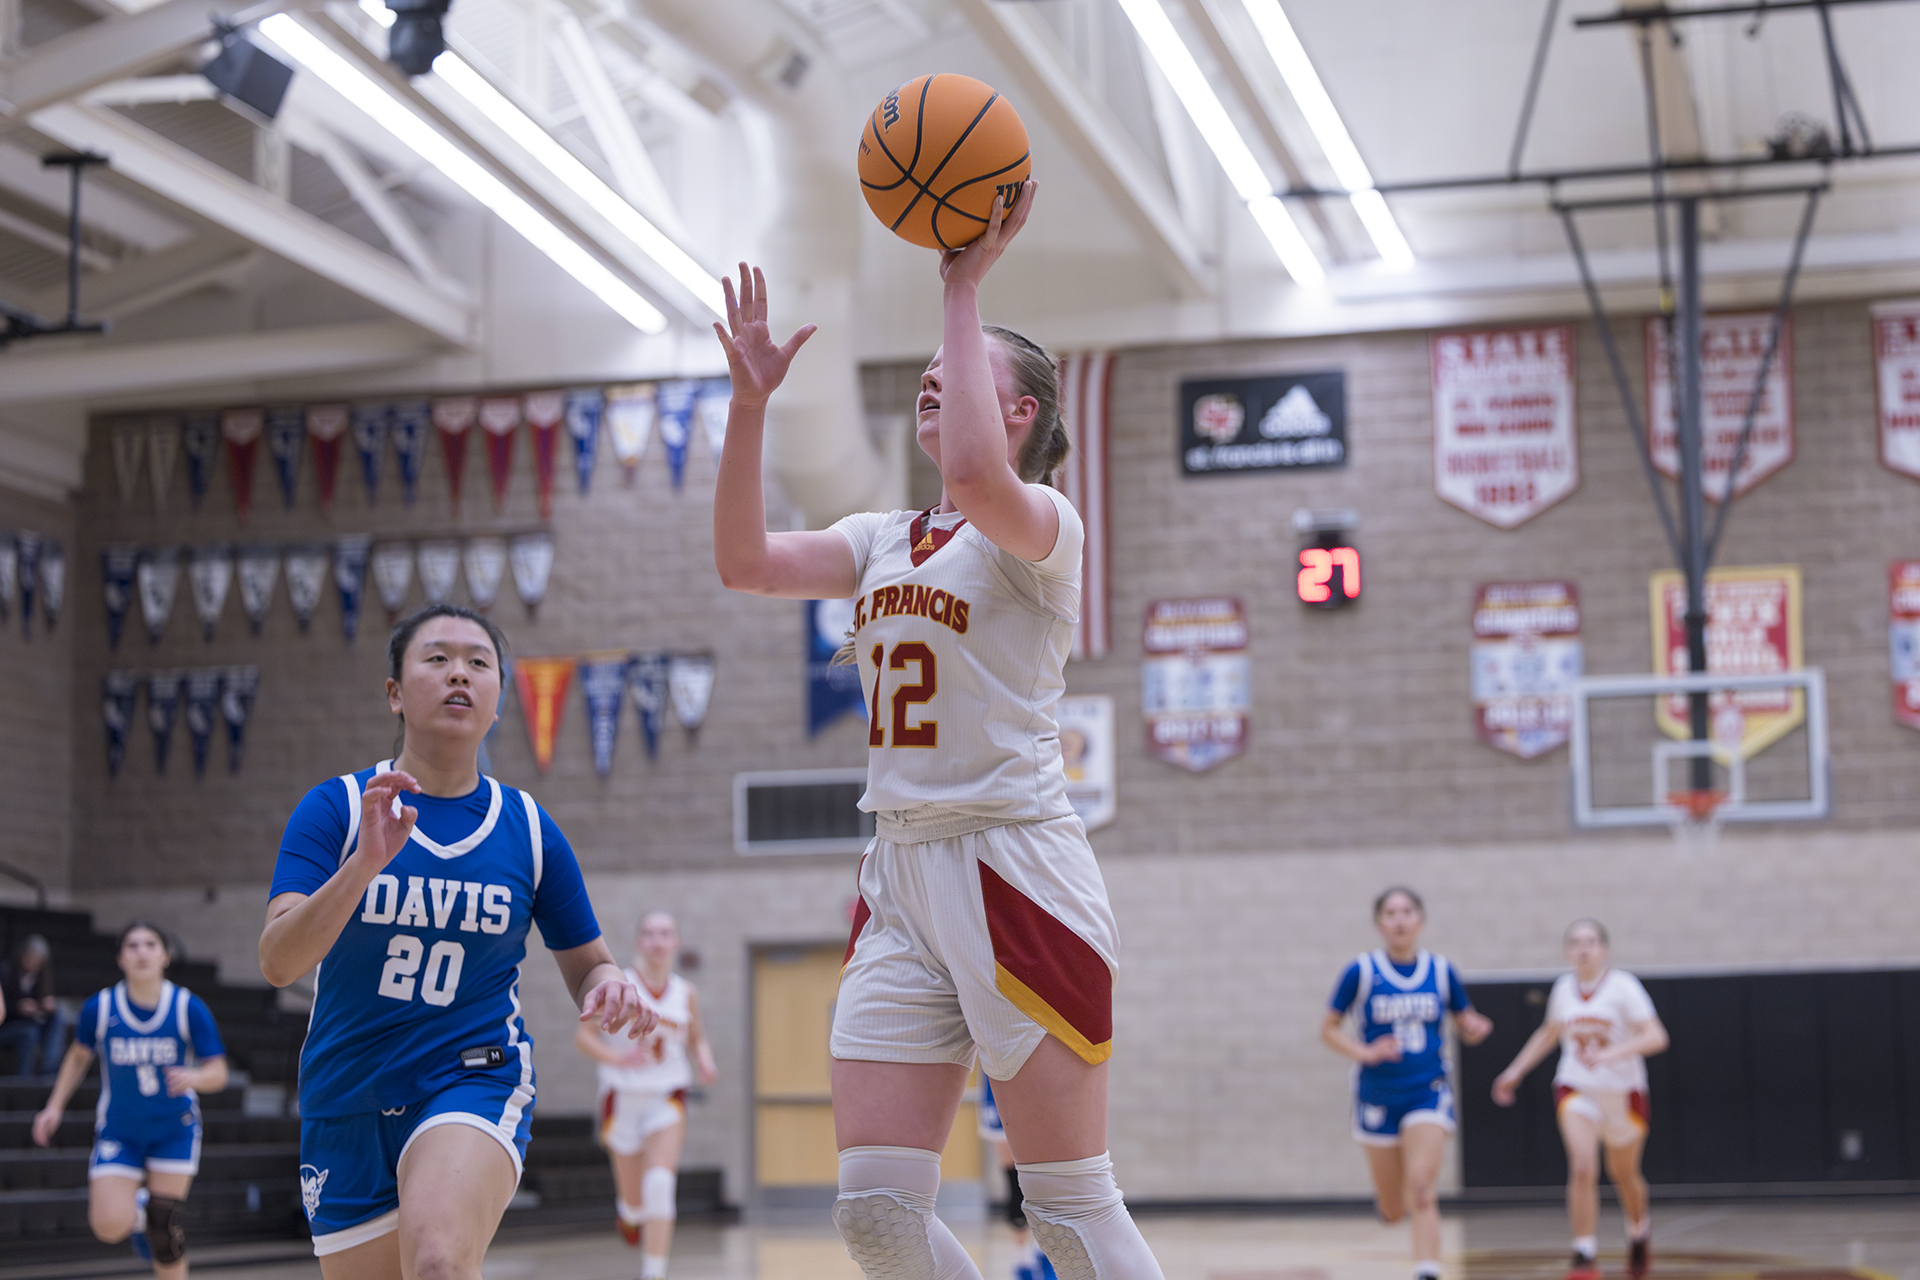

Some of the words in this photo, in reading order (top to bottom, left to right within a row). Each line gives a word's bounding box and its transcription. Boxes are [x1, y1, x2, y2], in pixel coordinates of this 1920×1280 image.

[1297, 547, 1361, 603] 27
[870, 584, 971, 635] FRANCIS
[868, 641, 938, 749] 12
[361, 874, 512, 935] DAVIS
[378, 934, 466, 1007] 20
[1371, 992, 1439, 1022] DAVIS
[110, 1037, 177, 1066] DAVIS
[490, 1050, 500, 1061] M
